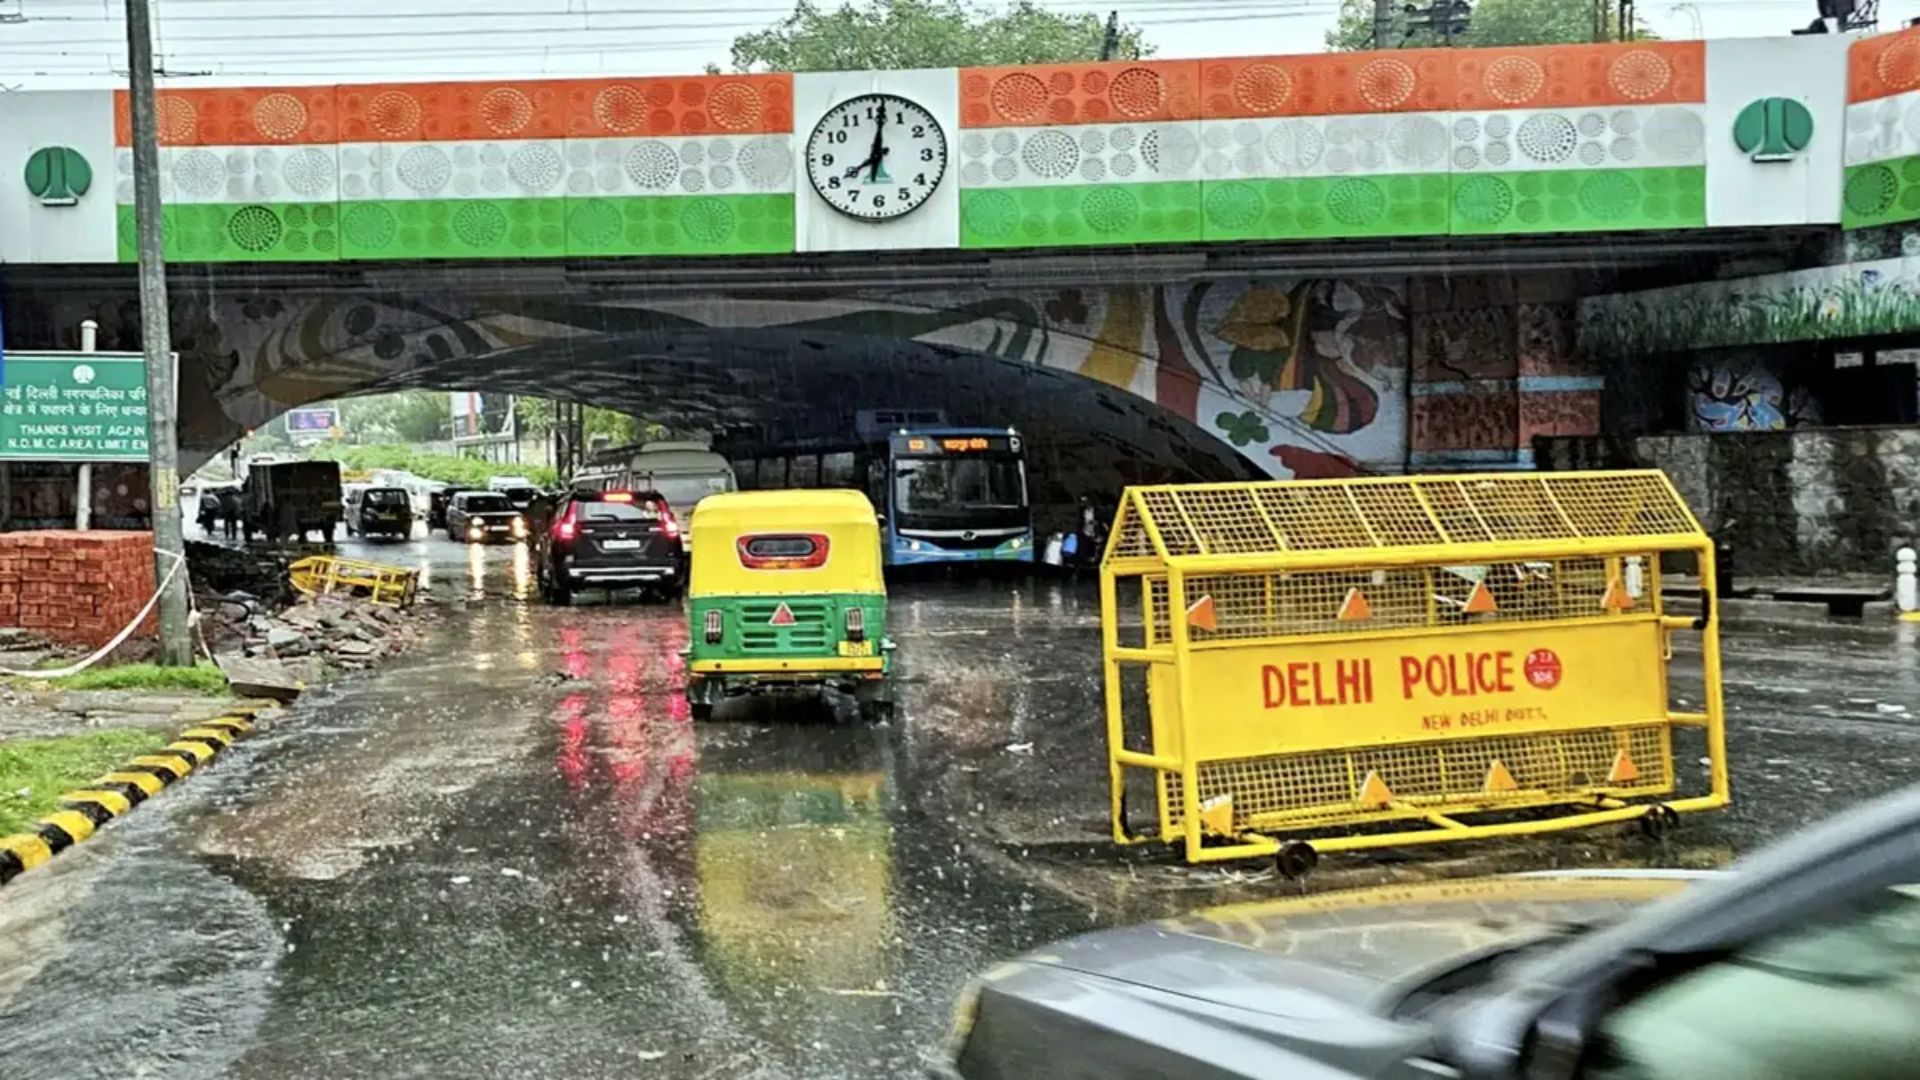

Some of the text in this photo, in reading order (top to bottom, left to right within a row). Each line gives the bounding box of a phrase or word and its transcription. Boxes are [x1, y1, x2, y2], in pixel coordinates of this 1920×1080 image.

[842, 114, 860, 127] 11
[896, 112, 904, 125] 1
[827, 130, 847, 144] 10
[911, 125, 925, 138] 2
[822, 153, 834, 166] 9
[920, 148, 933, 161] 3
[828, 176, 841, 189] 8
[913, 173, 926, 186] 4
[848, 190, 860, 202] 7
[898, 187, 911, 200] 5
[873, 195, 885, 208] 6
[4, 384, 20, 401] नई
[27, 384, 57, 400] दिल्ली
[127, 386, 147, 401] परि
[79, 402, 91, 416] के
[95, 401, 118, 418] लिए
[20, 424, 145, 436] THANKS VISIT AGAIN
[97, 439, 129, 450] LIMIT
[132, 439, 149, 450] EN
[1262, 651, 1515, 710] DELHI POLICE
[1421, 713, 1451, 730] NEW
[1460, 708, 1499, 727] DELHI
